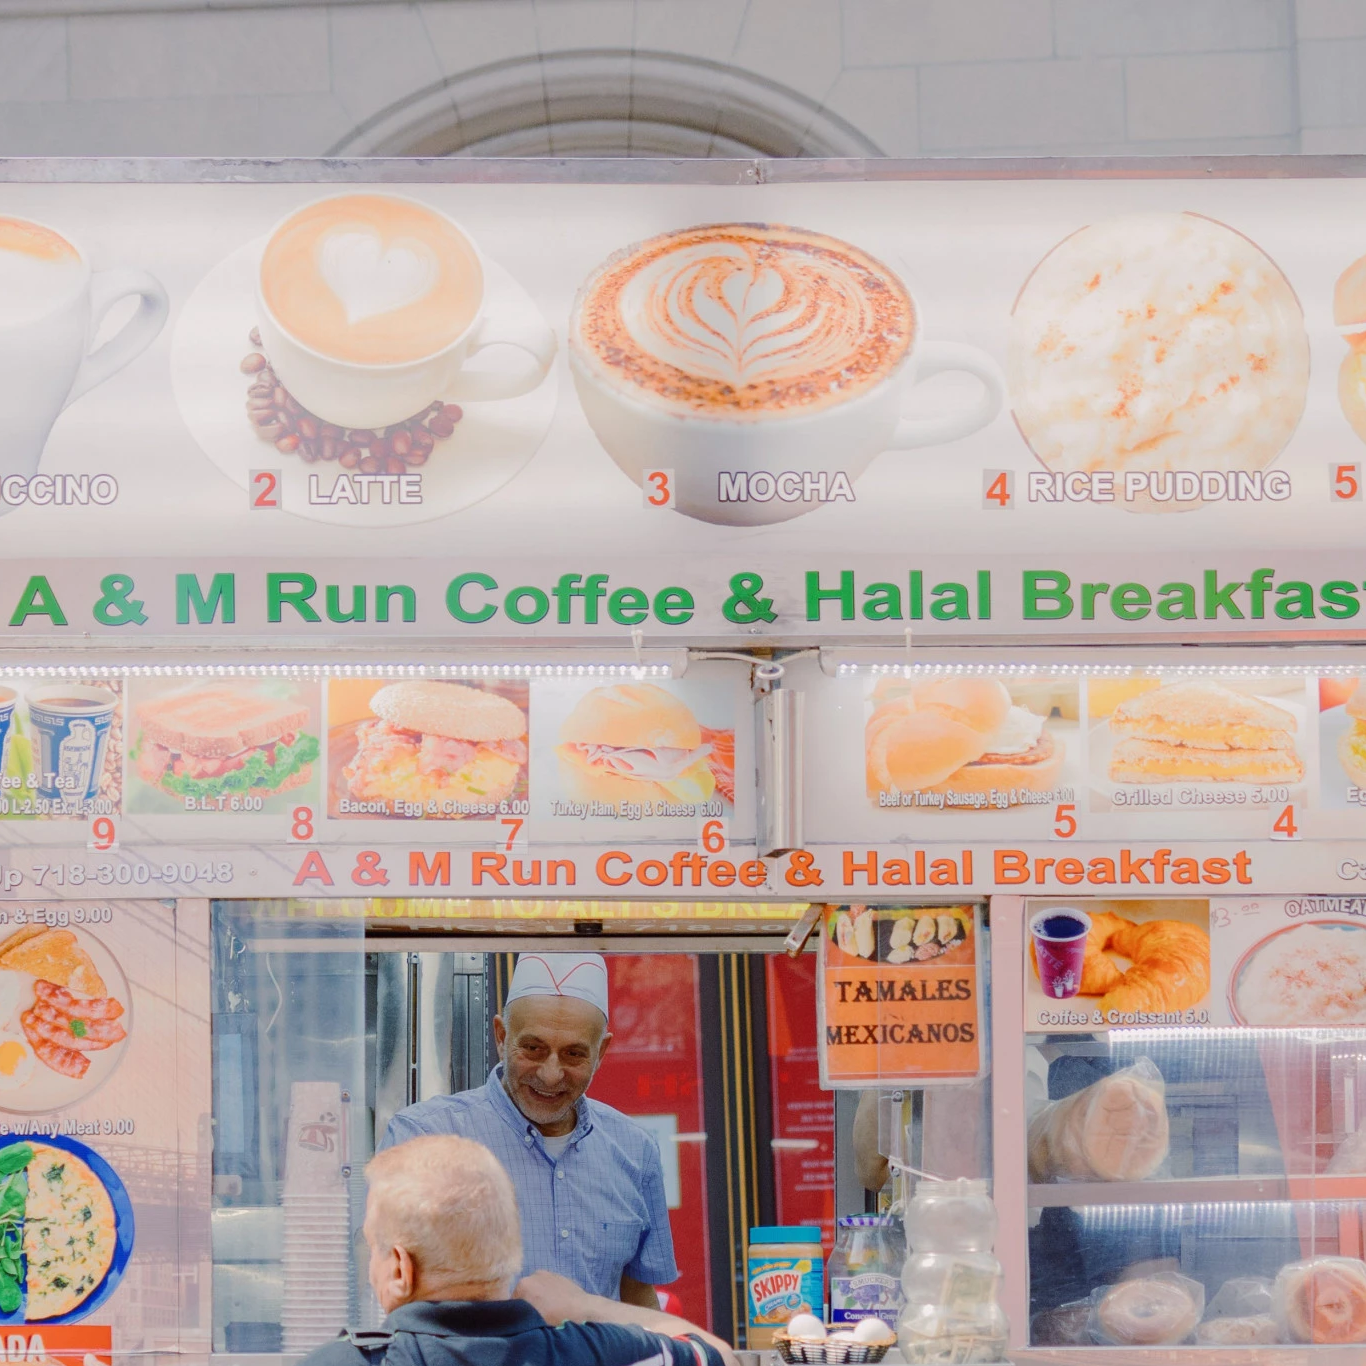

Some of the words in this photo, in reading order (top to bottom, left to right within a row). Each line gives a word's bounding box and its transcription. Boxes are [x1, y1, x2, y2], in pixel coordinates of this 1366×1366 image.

[253, 472, 278, 508] 2
[308, 473, 423, 506] LATTE
[647, 470, 671, 507] 3
[717, 470, 856, 503] MOCHA
[985, 471, 1011, 506] 4
[1028, 470, 1115, 504] RICE
[1123, 469, 1292, 502] PUDDING
[1334, 464, 1358, 500] 5
[8, 574, 68, 627] A
[91, 573, 149, 626] &
[175, 572, 237, 626] M
[266, 570, 417, 625] Run
[445, 571, 696, 626] Coffee
[721, 570, 779, 625] &
[805, 568, 991, 622] Halal
[24, 773, 41, 790] &
[43, 773, 76, 790] Tea
[1110, 787, 1173, 807] Grilled
[1177, 787, 1246, 805] Cheese
[1250, 786, 1290, 804] 5.00
[184, 795, 226, 812] B.L.T
[229, 795, 263, 812] 6.00
[1273, 804, 1298, 838] 4
[91, 816, 116, 851] 9
[290, 806, 314, 841] 8
[500, 818, 525, 851] 7
[701, 819, 726, 854] 6
[1053, 804, 1078, 839] 5
[32, 861, 234, 887] 718-300-9048
[292, 850, 334, 887] A
[350, 850, 390, 887] &
[408, 850, 451, 887] M
[471, 850, 577, 888] Run
[595, 850, 767, 888] Coffee
[784, 850, 825, 887] &
[843, 849, 973, 886] Halal
[994, 848, 1253, 886] Breakfast
[833, 979, 972, 1002] TAMALES
[825, 1022, 976, 1047] MEXICANOS
[753, 1273, 800, 1302] SKIPPY
